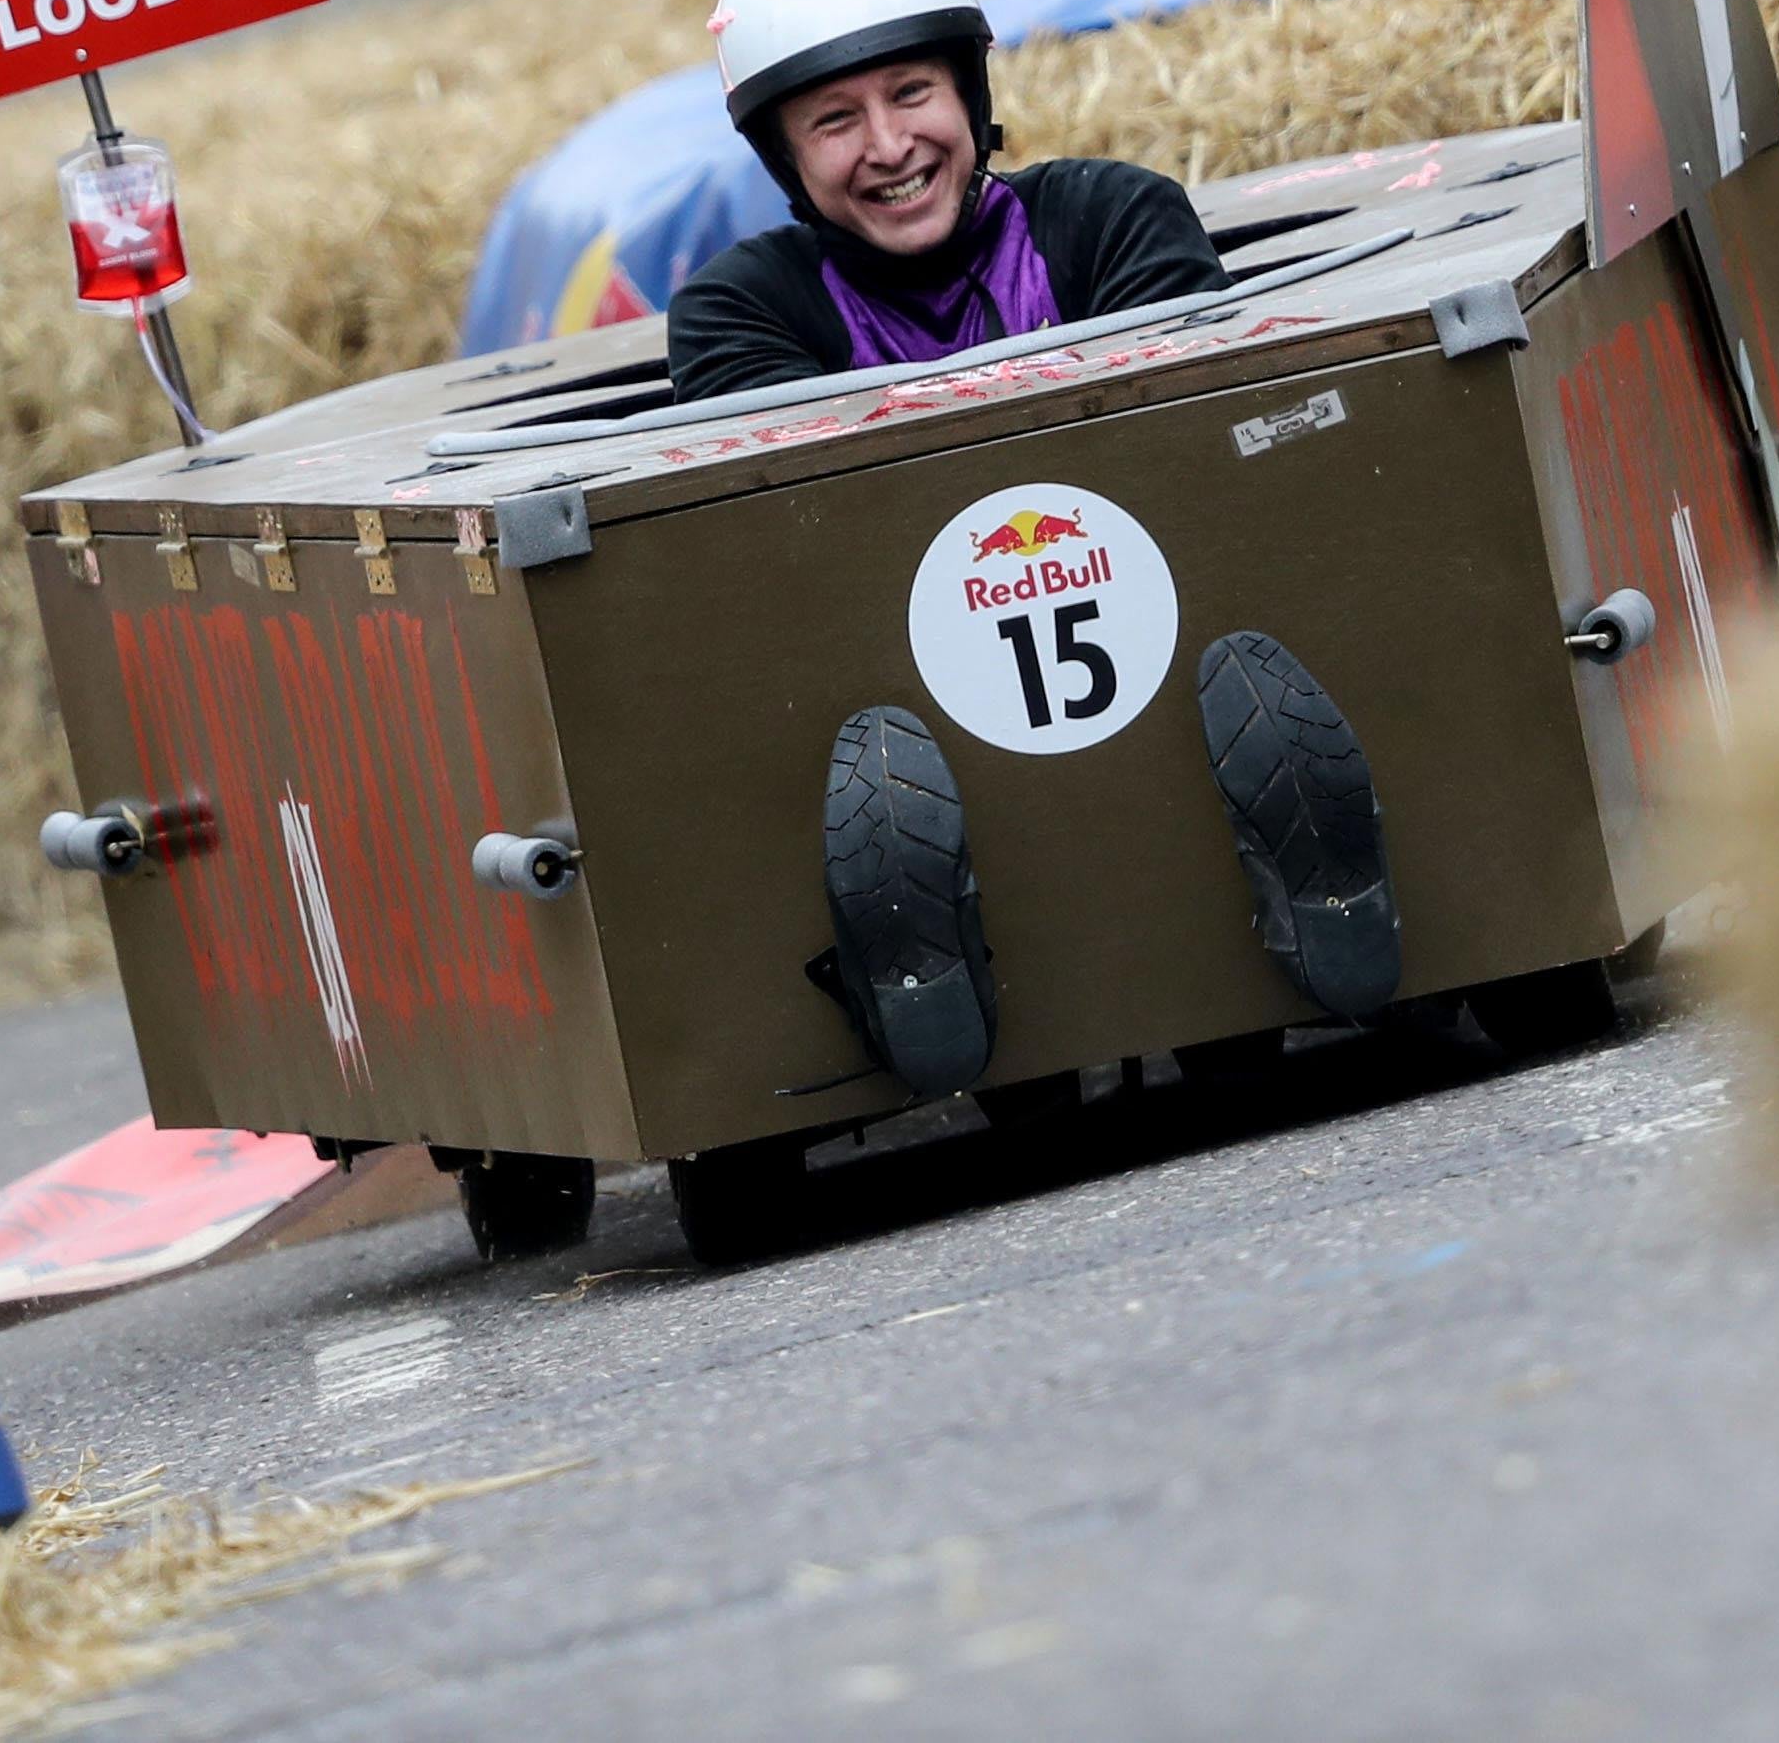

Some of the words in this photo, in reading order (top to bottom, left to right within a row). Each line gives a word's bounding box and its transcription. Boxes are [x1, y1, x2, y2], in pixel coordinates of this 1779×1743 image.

[964, 564, 1038, 612] Red
[1039, 547, 1112, 595] Bull
[997, 599, 1118, 729] 15
